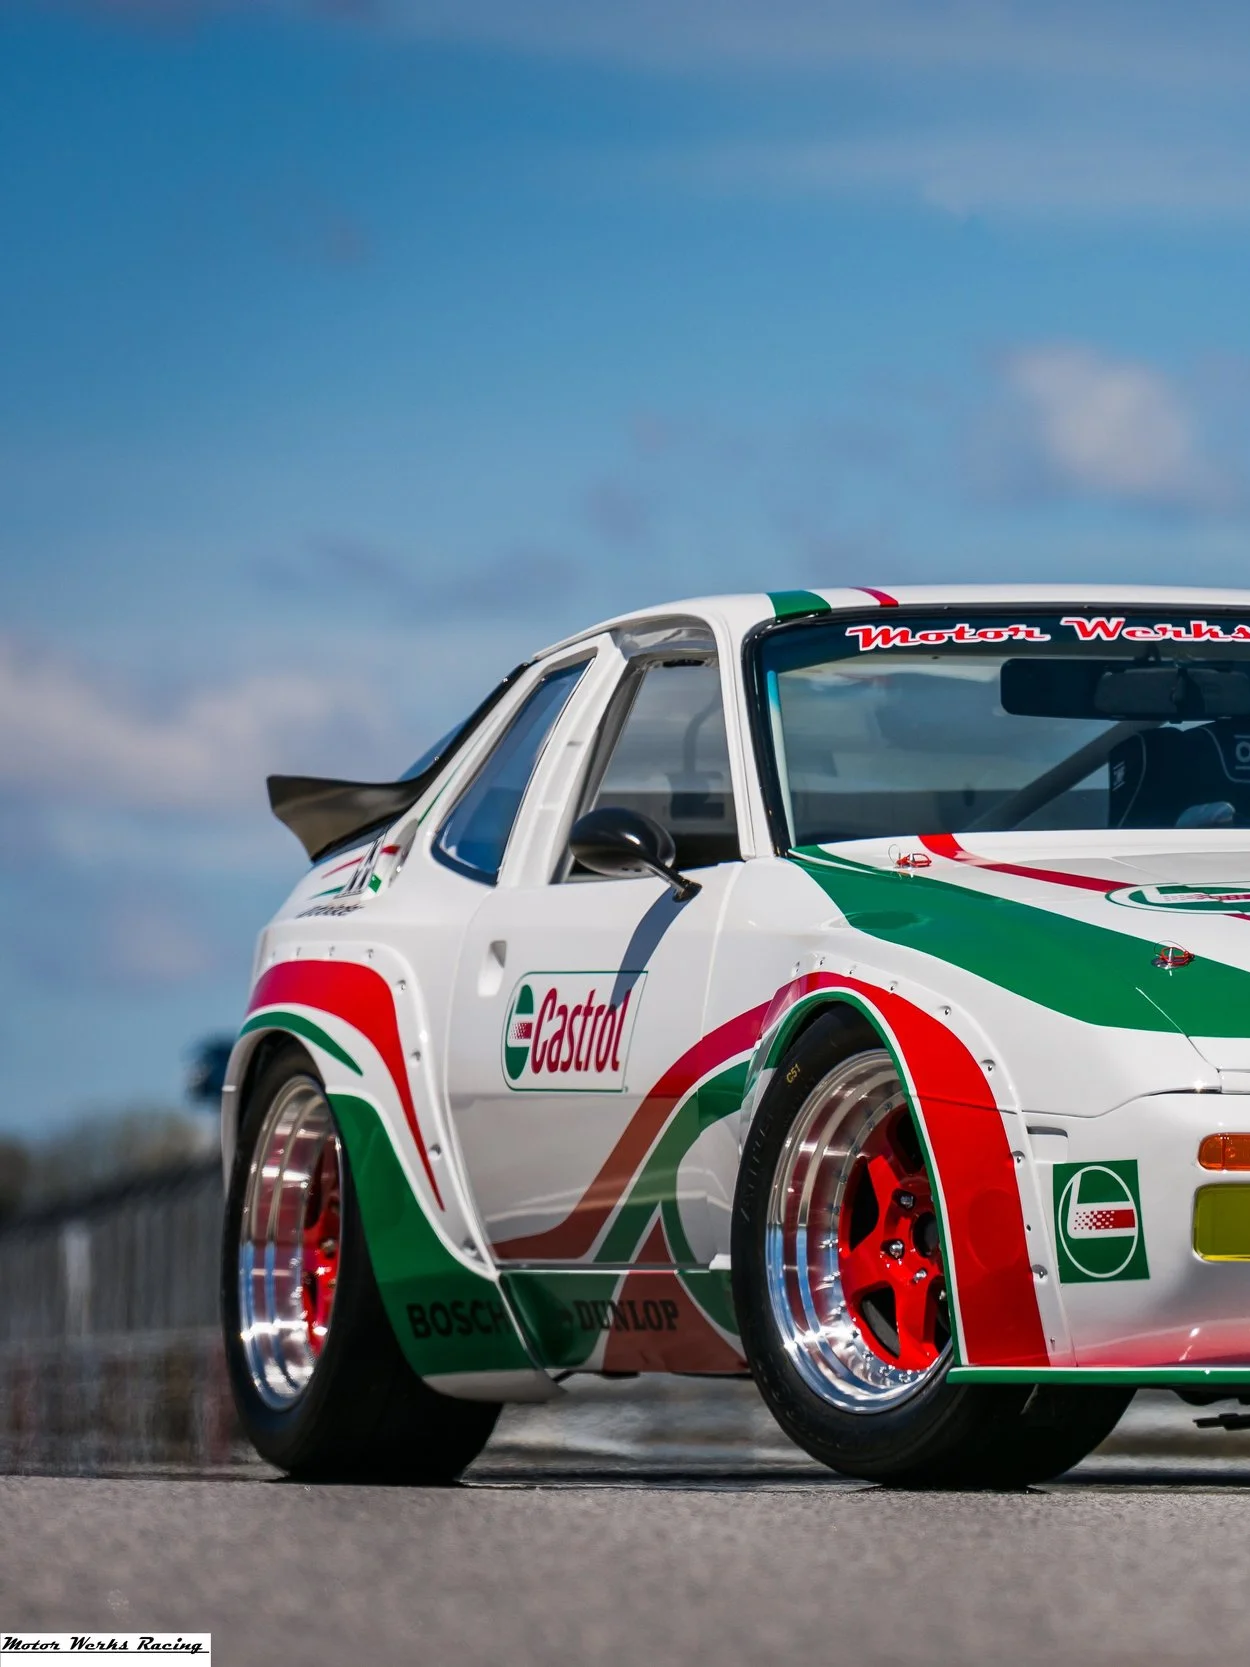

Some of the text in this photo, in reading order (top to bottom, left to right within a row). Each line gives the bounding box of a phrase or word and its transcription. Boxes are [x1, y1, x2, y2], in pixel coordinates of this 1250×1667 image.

[848, 625, 1049, 651] Motor
[531, 988, 632, 1074] Castrol
[406, 1300, 510, 1338] BOSCH
[573, 1300, 679, 1331] DUNLOP
